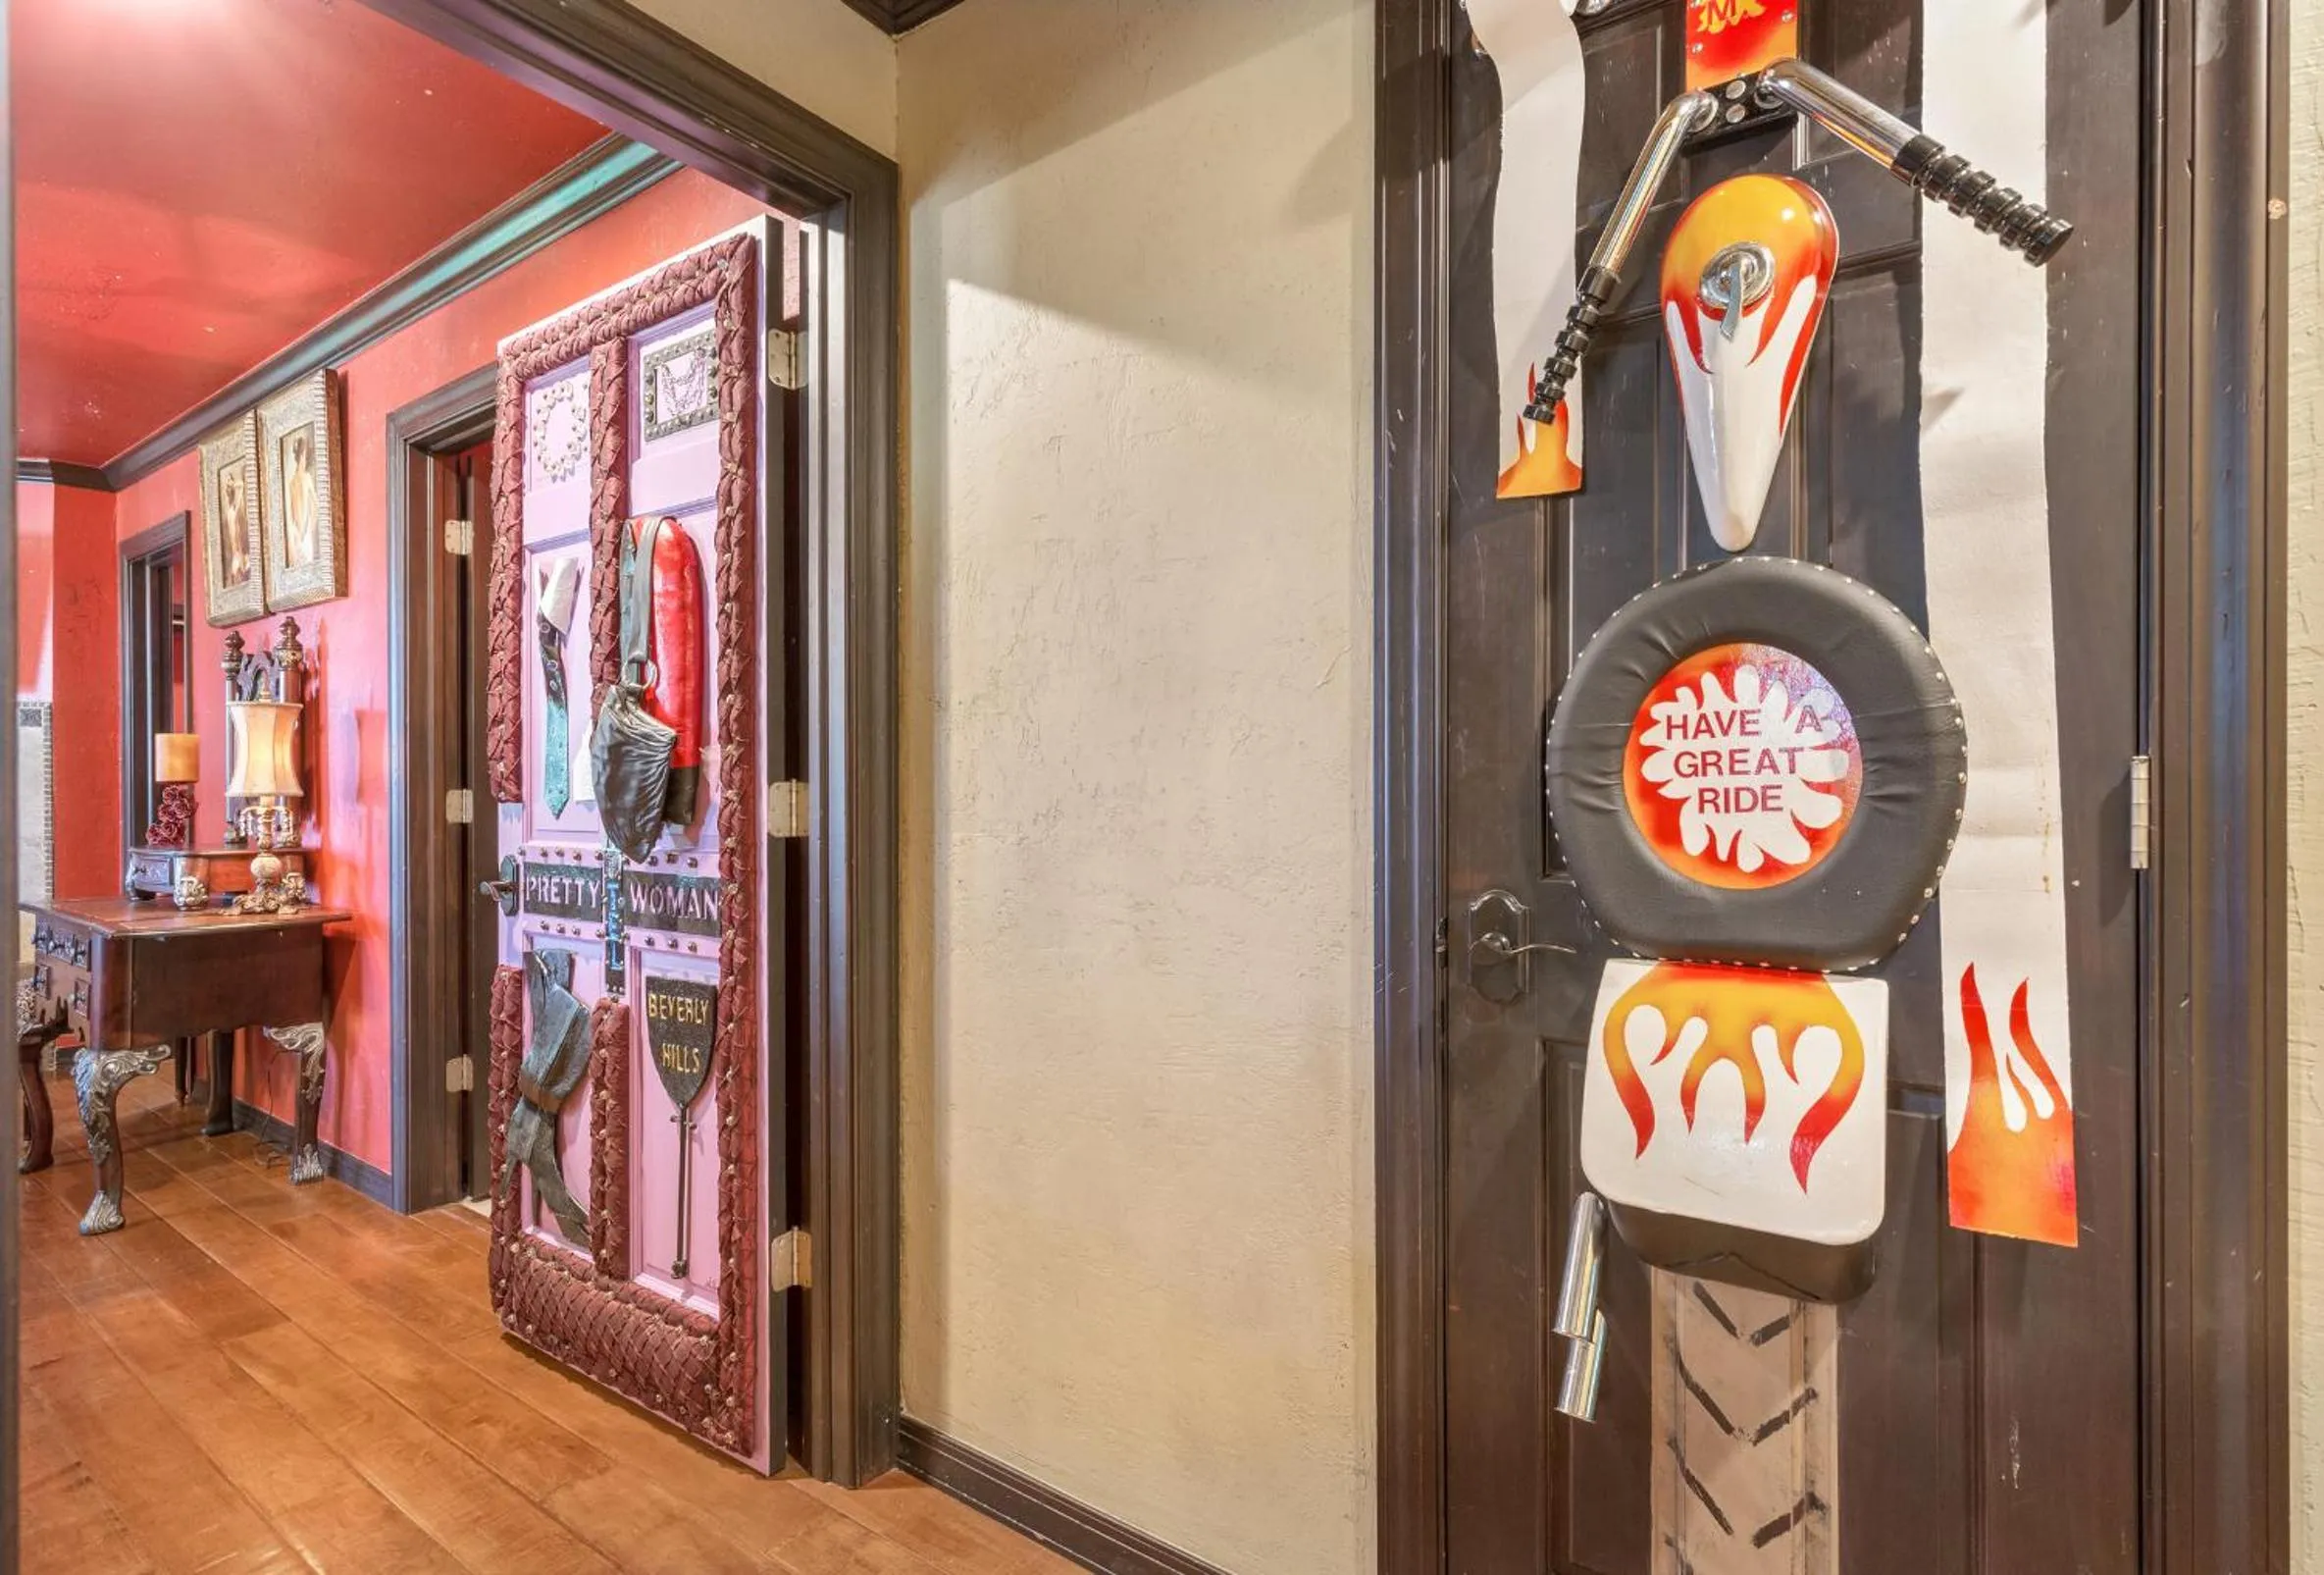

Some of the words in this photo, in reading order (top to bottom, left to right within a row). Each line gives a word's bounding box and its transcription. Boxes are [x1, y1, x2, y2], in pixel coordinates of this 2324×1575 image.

[1666, 708, 1762, 741] HAVE
[1794, 705, 1824, 734] A
[1673, 746, 1805, 779] GREAT
[1697, 784, 1784, 814] RIDE
[525, 874, 601, 909] PRETTY
[629, 882, 718, 921] WOMAN
[647, 992, 709, 1025] BEVERLY
[662, 1042, 699, 1074] HILLS
